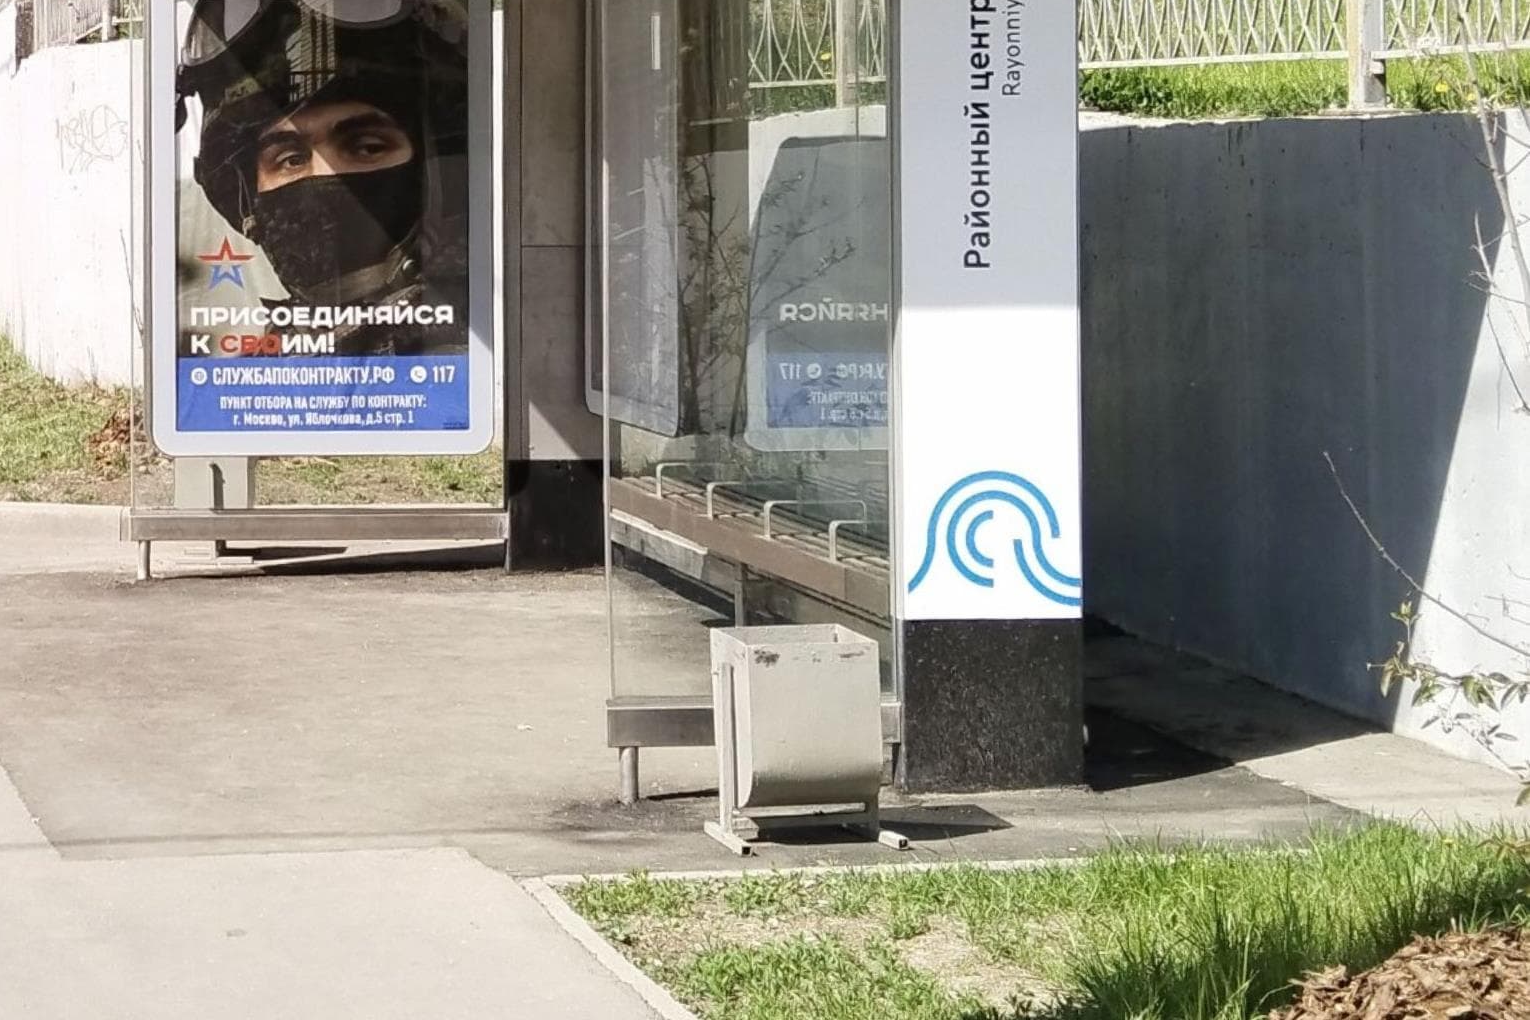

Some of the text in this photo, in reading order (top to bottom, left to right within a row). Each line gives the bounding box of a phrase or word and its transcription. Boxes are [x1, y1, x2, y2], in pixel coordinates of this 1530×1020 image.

[964, 102, 990, 269] Районный
[191, 300, 454, 328] ПРИСОЕДИНЯЙСЯ
[191, 332, 335, 354] К СВОИМ!
[212, 365, 455, 386] СЛУЖБАПОКОНТРАКТУ.РФ 117
[220, 394, 427, 410] ПУНКТ ОТБОРА НА СЛУЖБУ ПО КОНТРАКТУ:
[233, 414, 242, 426] г.
[244, 412, 287, 427] Москва,
[288, 414, 303, 427] ул.
[385, 413, 406, 427] стр.
[408, 410, 414, 423] 1
